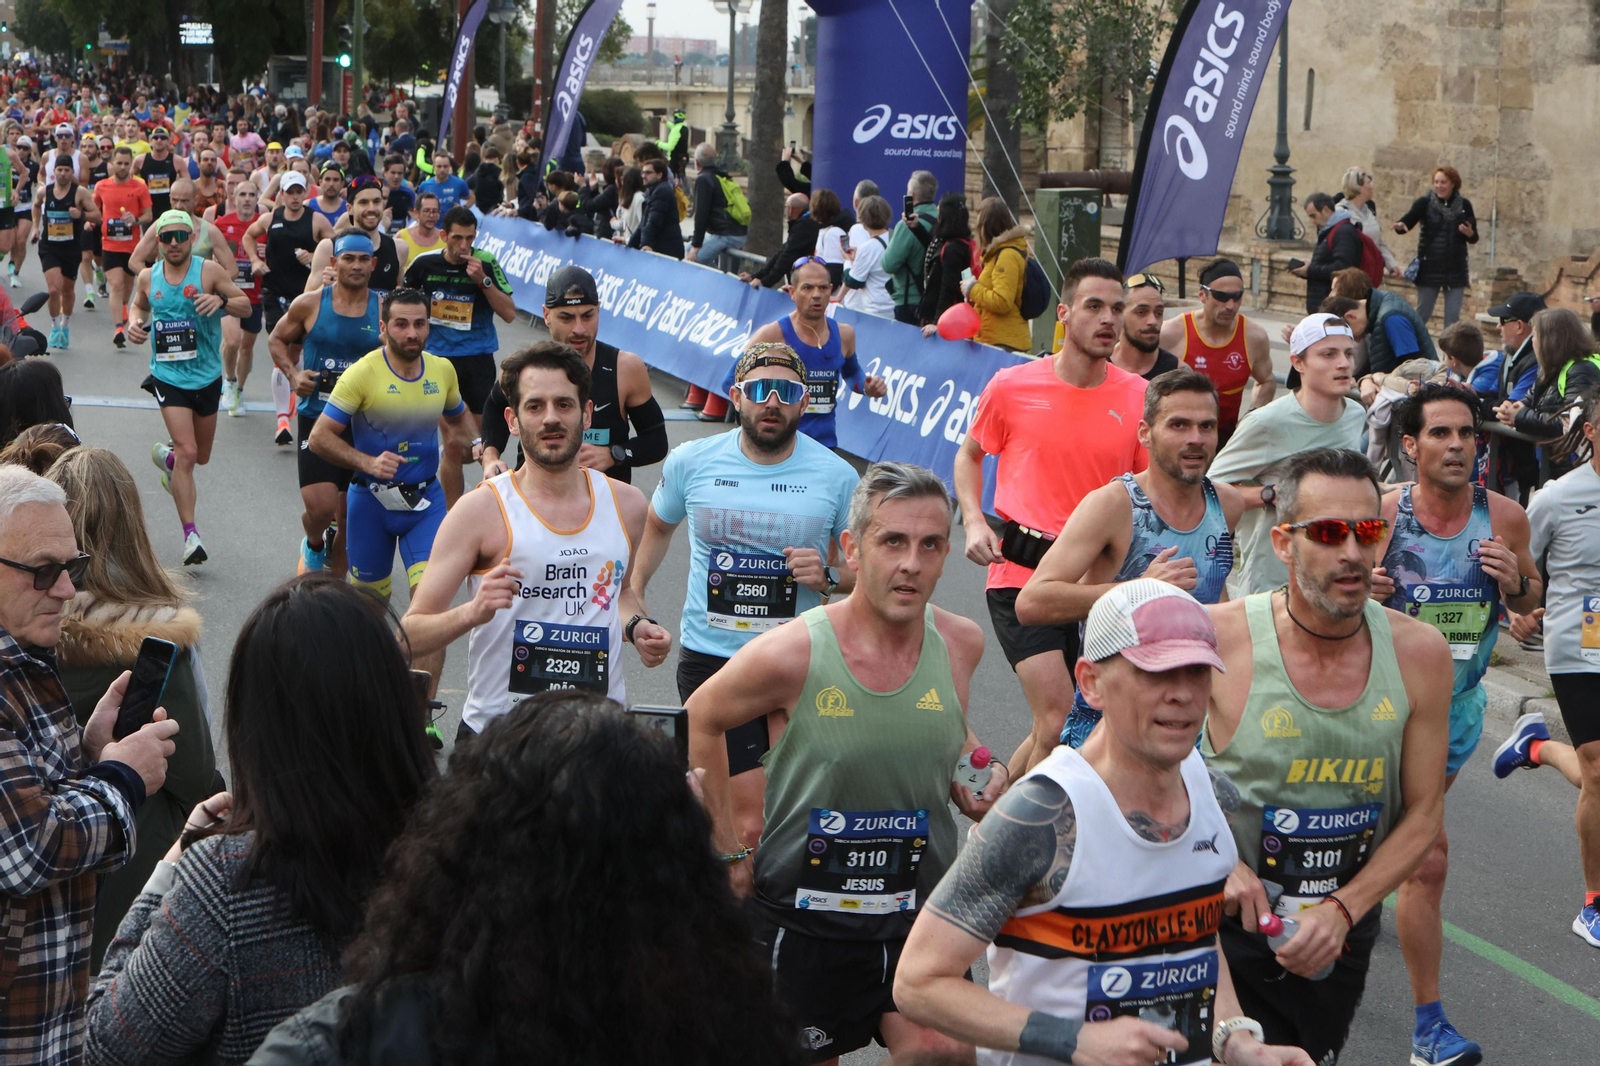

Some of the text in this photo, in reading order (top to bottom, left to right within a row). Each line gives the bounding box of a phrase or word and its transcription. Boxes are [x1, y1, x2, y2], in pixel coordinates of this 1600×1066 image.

[452, 35, 471, 80] asics
[565, 33, 593, 95] asics
[1184, 2, 1245, 123] asics
[1225, 97, 1243, 138] sound
[1237, 68, 1256, 98] mind,
[1248, 27, 1267, 66] sound
[890, 113, 957, 141] asics
[884, 148, 911, 156] sound
[933, 150, 952, 158] sound
[505, 245, 533, 278] asics
[623, 283, 659, 323] asics
[657, 296, 696, 336] asics
[165, 321, 190, 329] ZURICH
[688, 308, 738, 348] asics
[166, 334, 180, 343] 2341
[808, 385, 824, 393] 2131
[558, 548, 589, 557] JOÃO
[545, 562, 587, 581] Brain
[739, 558, 788, 570] ZURICH
[736, 583, 767, 597] 2560
[1437, 588, 1482, 598] ZURICH
[565, 601, 587, 616] UK
[734, 605, 768, 615] ORETTI
[1435, 612, 1463, 624] 1327
[550, 629, 600, 644] ZURICH
[546, 658, 580, 675] 2329
[915, 702, 944, 711] adidas
[1371, 712, 1397, 720] adidas
[1286, 757, 1385, 783] BIKILA
[852, 816, 917, 831] ZURICH
[1307, 809, 1370, 829] ZURICH
[847, 850, 887, 867] 3110
[1302, 849, 1342, 869] 3101
[841, 878, 885, 891] JESUS
[1298, 877, 1339, 894] ANGEL
[1140, 962, 1208, 989] ZURICH
